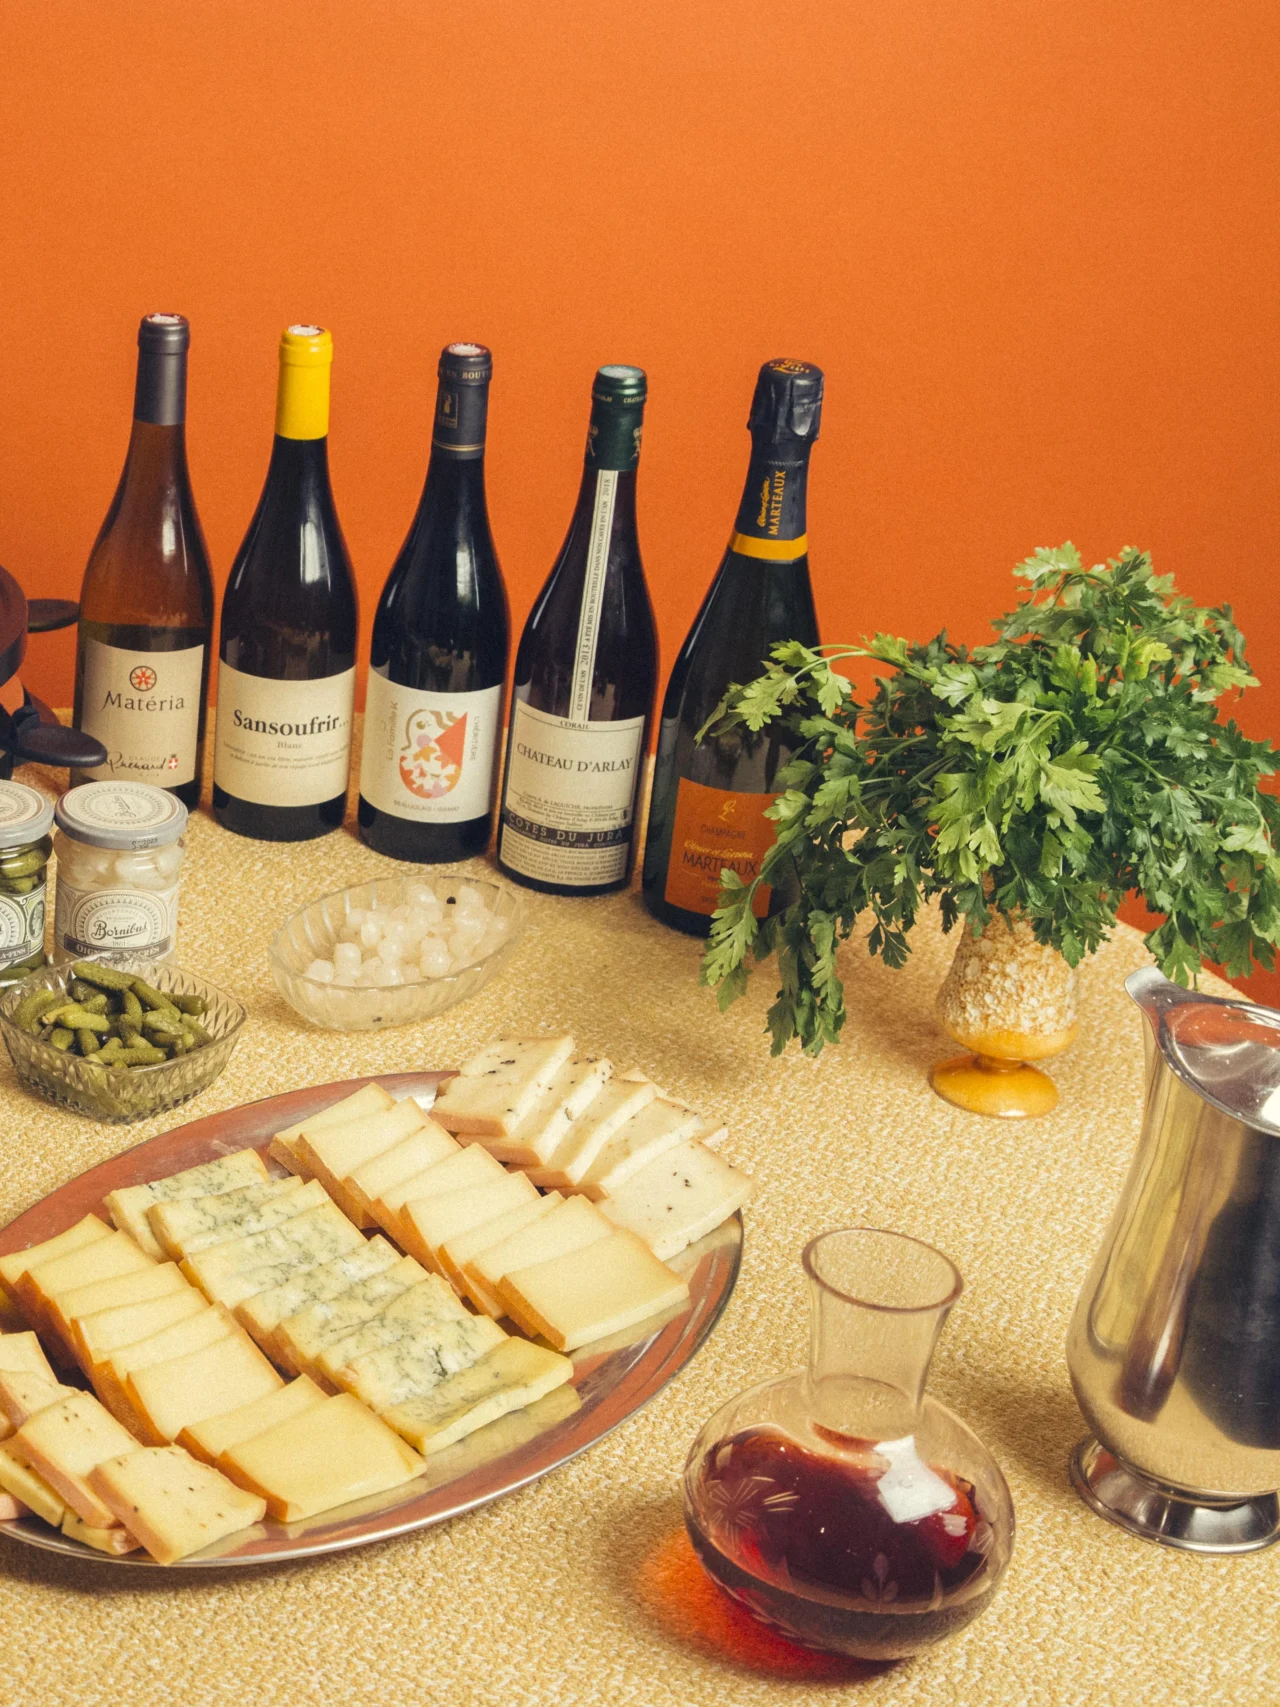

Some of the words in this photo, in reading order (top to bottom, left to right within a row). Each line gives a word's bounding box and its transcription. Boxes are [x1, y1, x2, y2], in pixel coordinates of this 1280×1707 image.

[768, 471, 786, 535] MARTEAUX
[581, 644, 590, 666] 2013
[99, 690, 185, 712] Matéria
[391, 701, 399, 710] K
[233, 709, 349, 736] Sansoufrir...
[277, 741, 302, 749] Blanc
[517, 743, 573, 770] CHATEAU
[577, 757, 633, 773] D'ARLAY
[556, 831, 577, 842] DU
[587, 830, 623, 842] JURA
[700, 824, 745, 840] CHAMPAGNE
[682, 851, 758, 876] MARTEAUX
[91, 920, 148, 940] Bornibus
